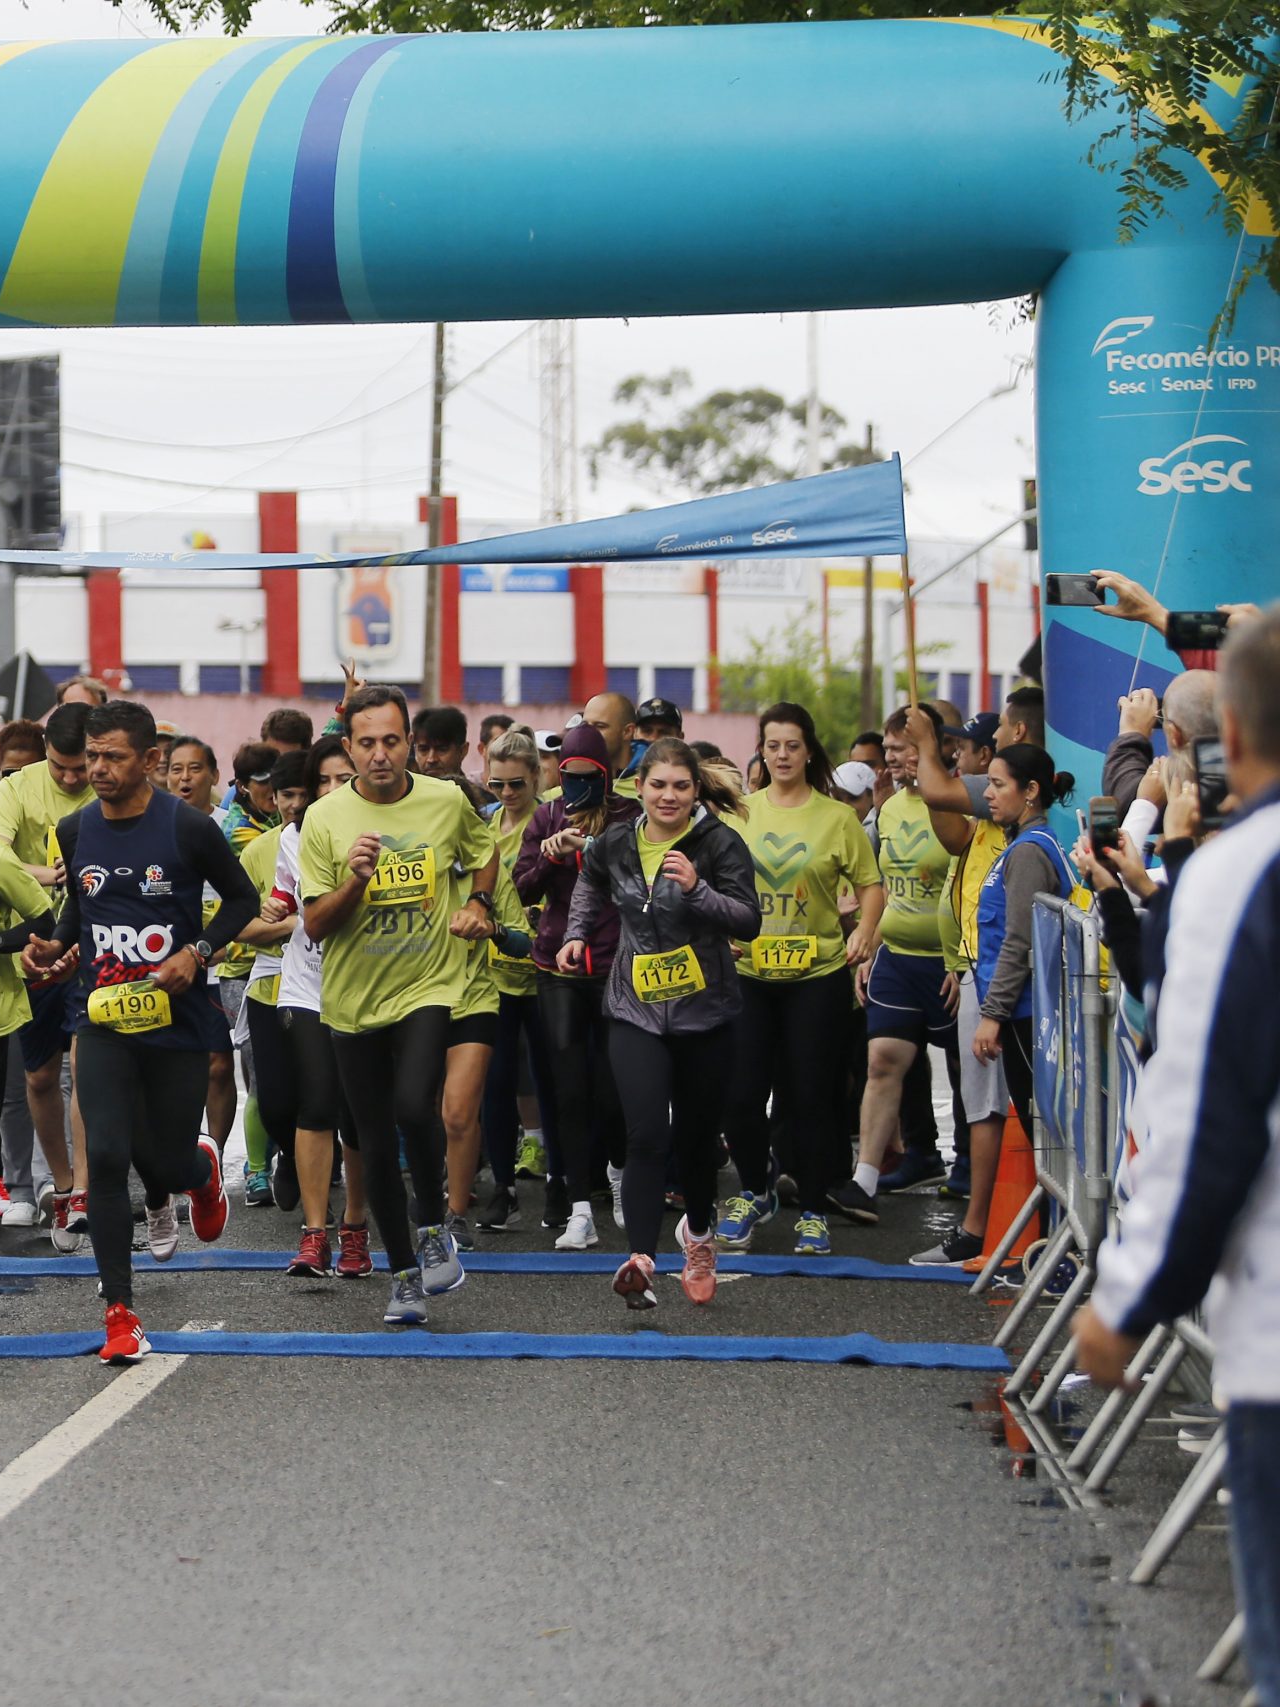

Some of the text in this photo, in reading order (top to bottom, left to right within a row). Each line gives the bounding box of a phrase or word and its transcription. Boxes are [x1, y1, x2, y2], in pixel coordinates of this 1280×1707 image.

[1106, 345, 1251, 373] Fecomércio
[1108, 377, 1257, 395] Sesc Senac IFPD
[1136, 457, 1252, 496] Sesc
[752, 527, 798, 547] Sesc
[373, 863, 424, 885] 1196
[760, 892, 808, 917] BTx
[761, 949, 806, 964] 1177
[640, 963, 690, 986] 1172
[100, 994, 156, 1017] 1190
